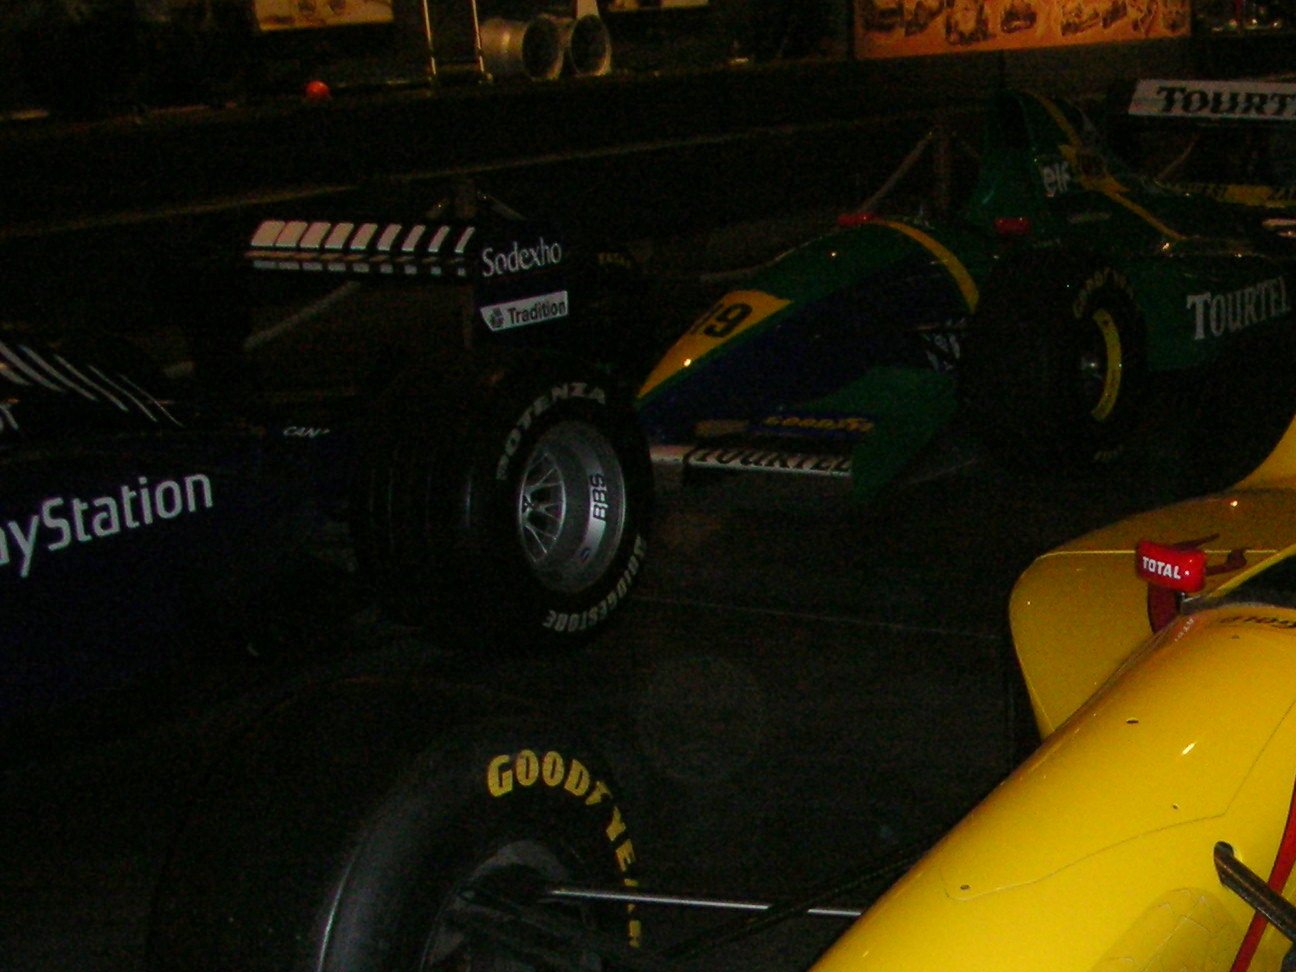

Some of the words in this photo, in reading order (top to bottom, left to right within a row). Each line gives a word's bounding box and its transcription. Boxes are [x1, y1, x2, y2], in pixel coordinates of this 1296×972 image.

[481, 236, 563, 278] Sodexho
[508, 301, 566, 325] Tradition
[1186, 276, 1292, 340] TOURTEL
[590, 474, 609, 526] BBS
[1142, 556, 1182, 580] TOTAL
